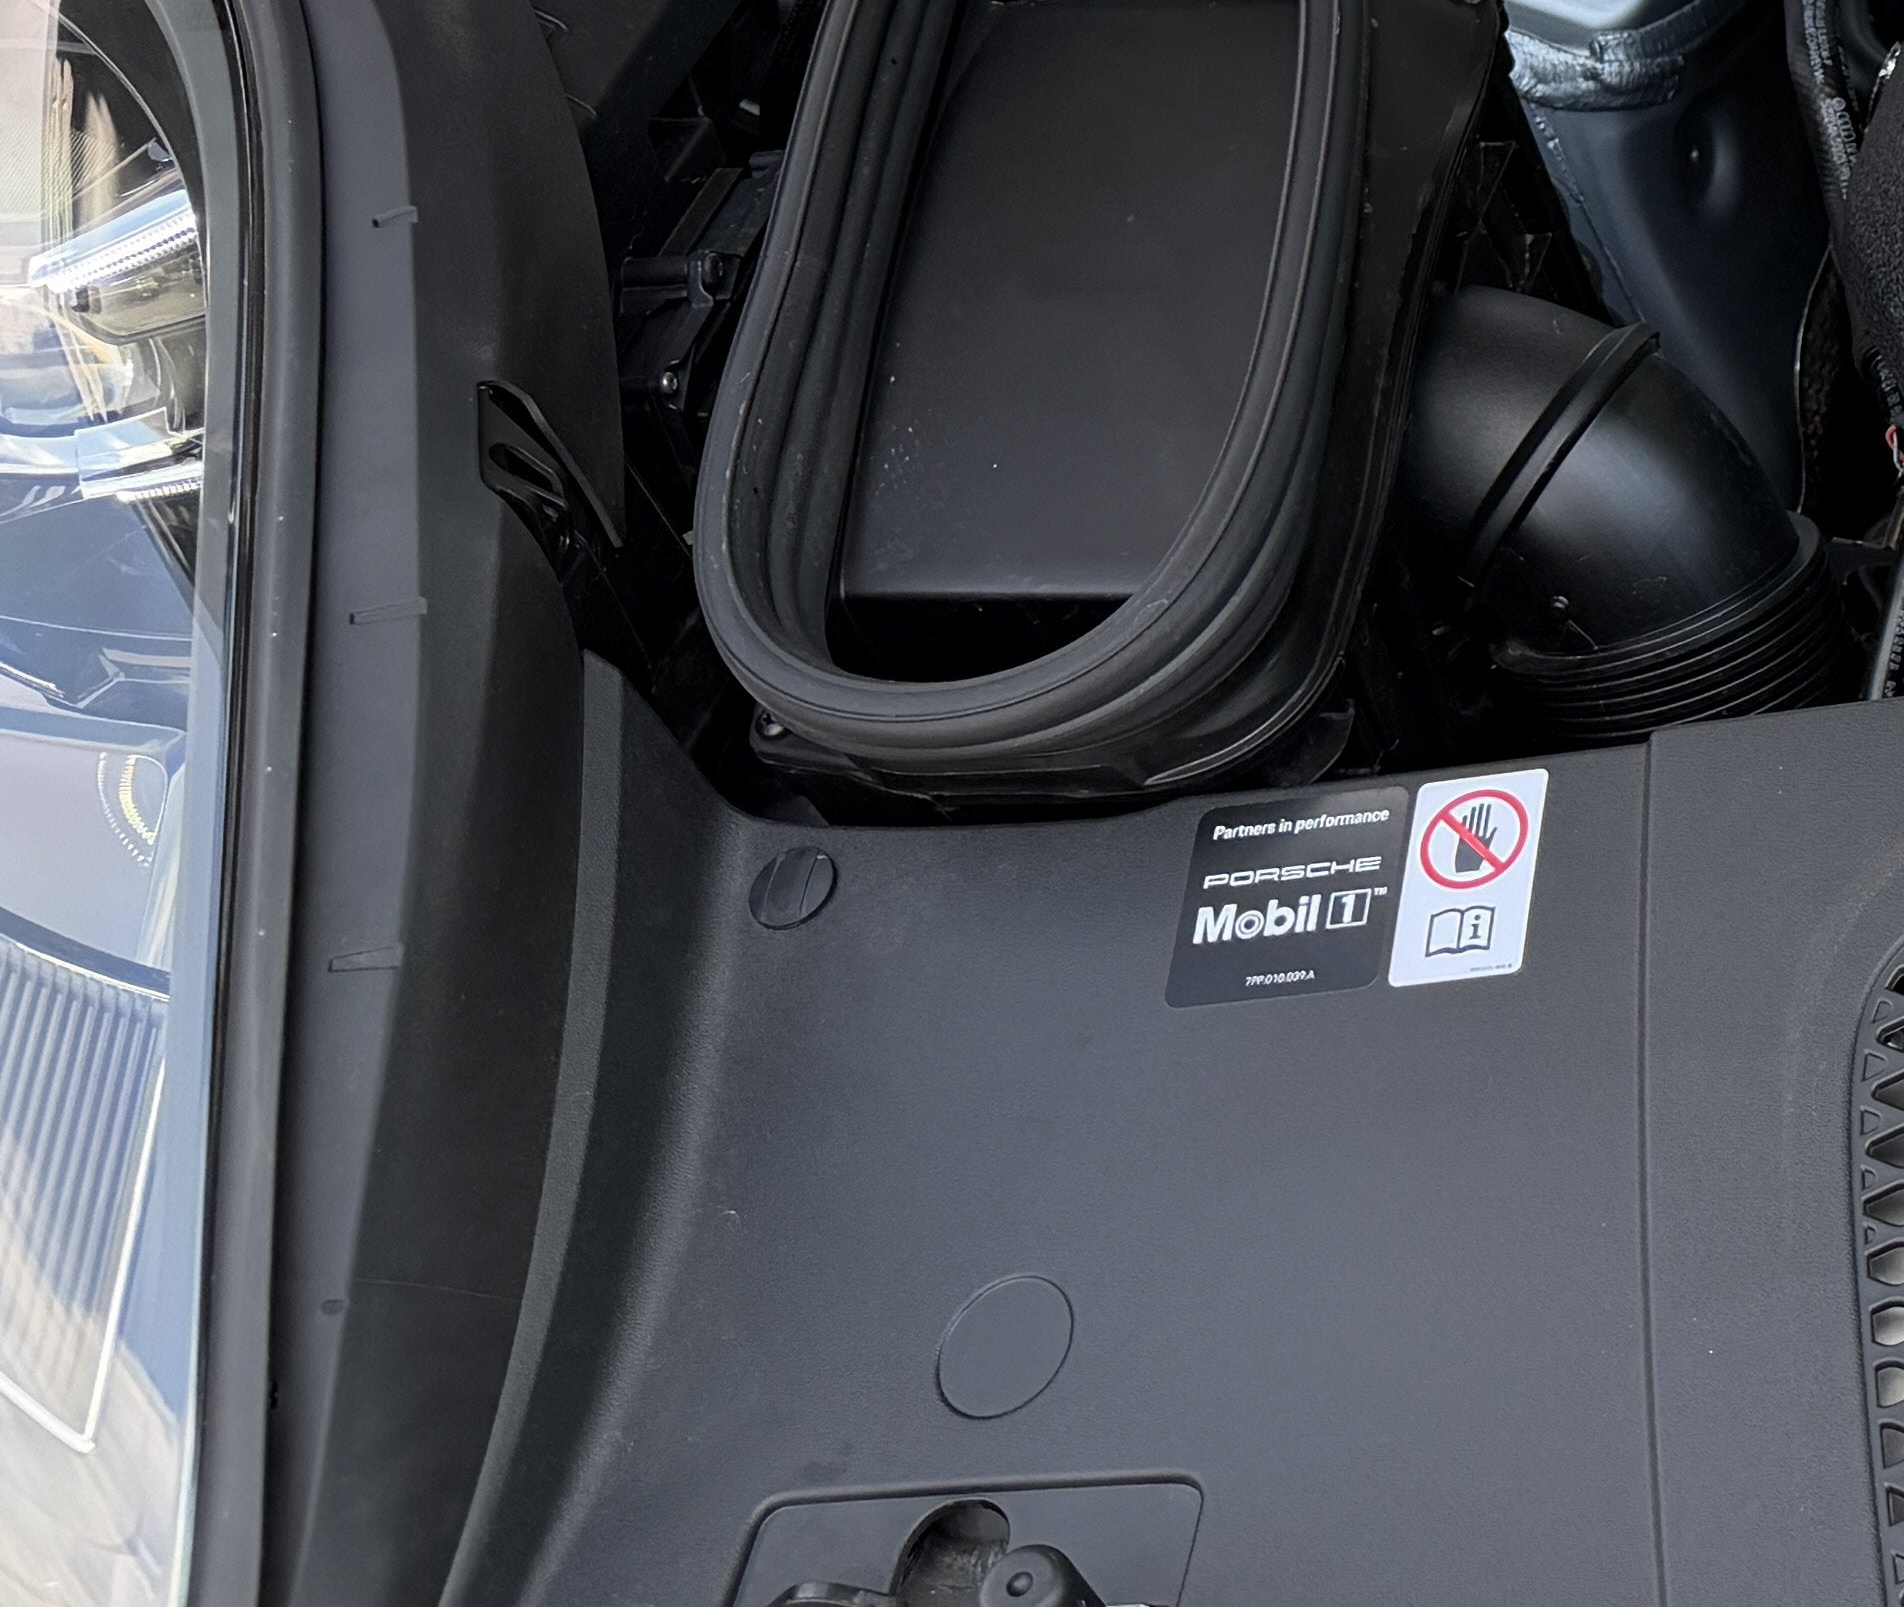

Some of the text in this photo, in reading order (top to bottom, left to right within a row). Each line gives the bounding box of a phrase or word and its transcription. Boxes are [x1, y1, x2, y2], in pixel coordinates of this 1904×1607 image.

[1213, 809, 1391, 841] Partners in performance
[1203, 856, 1382, 889] PORSCHE
[1193, 894, 1322, 944] Mobil
